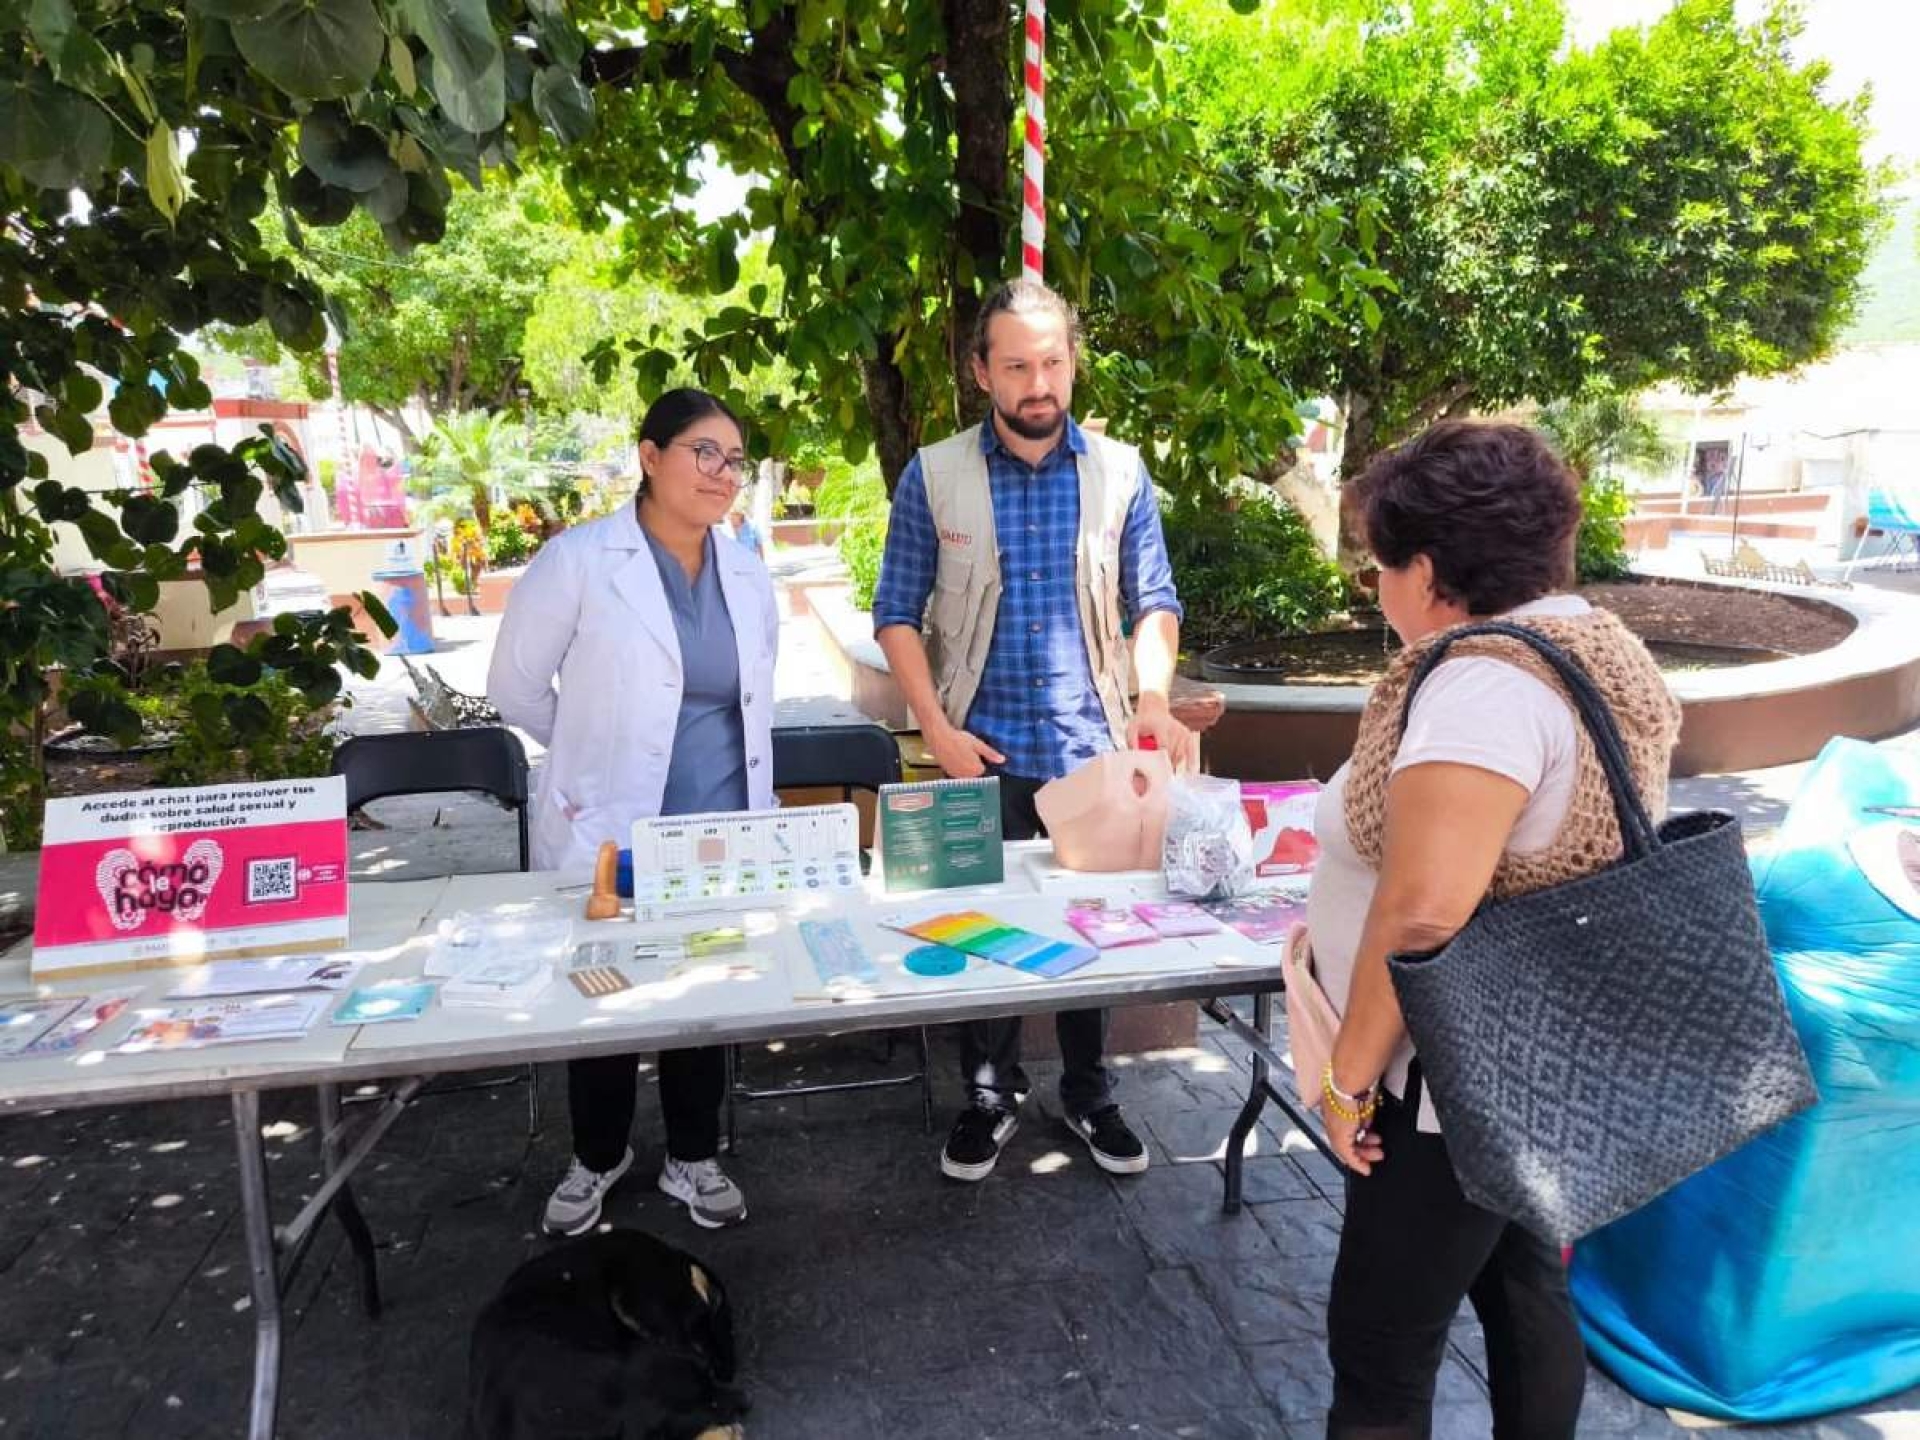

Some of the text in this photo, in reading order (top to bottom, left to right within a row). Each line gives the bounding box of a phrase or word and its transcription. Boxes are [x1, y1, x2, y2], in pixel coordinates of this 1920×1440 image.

[82, 784, 315, 813] Accede al chat para resolver tus
[149, 806, 191, 821] sobre
[195, 801, 235, 816] salud
[239, 797, 284, 813] sexual
[288, 799, 297, 811] y
[152, 816, 247, 834] reproductiva
